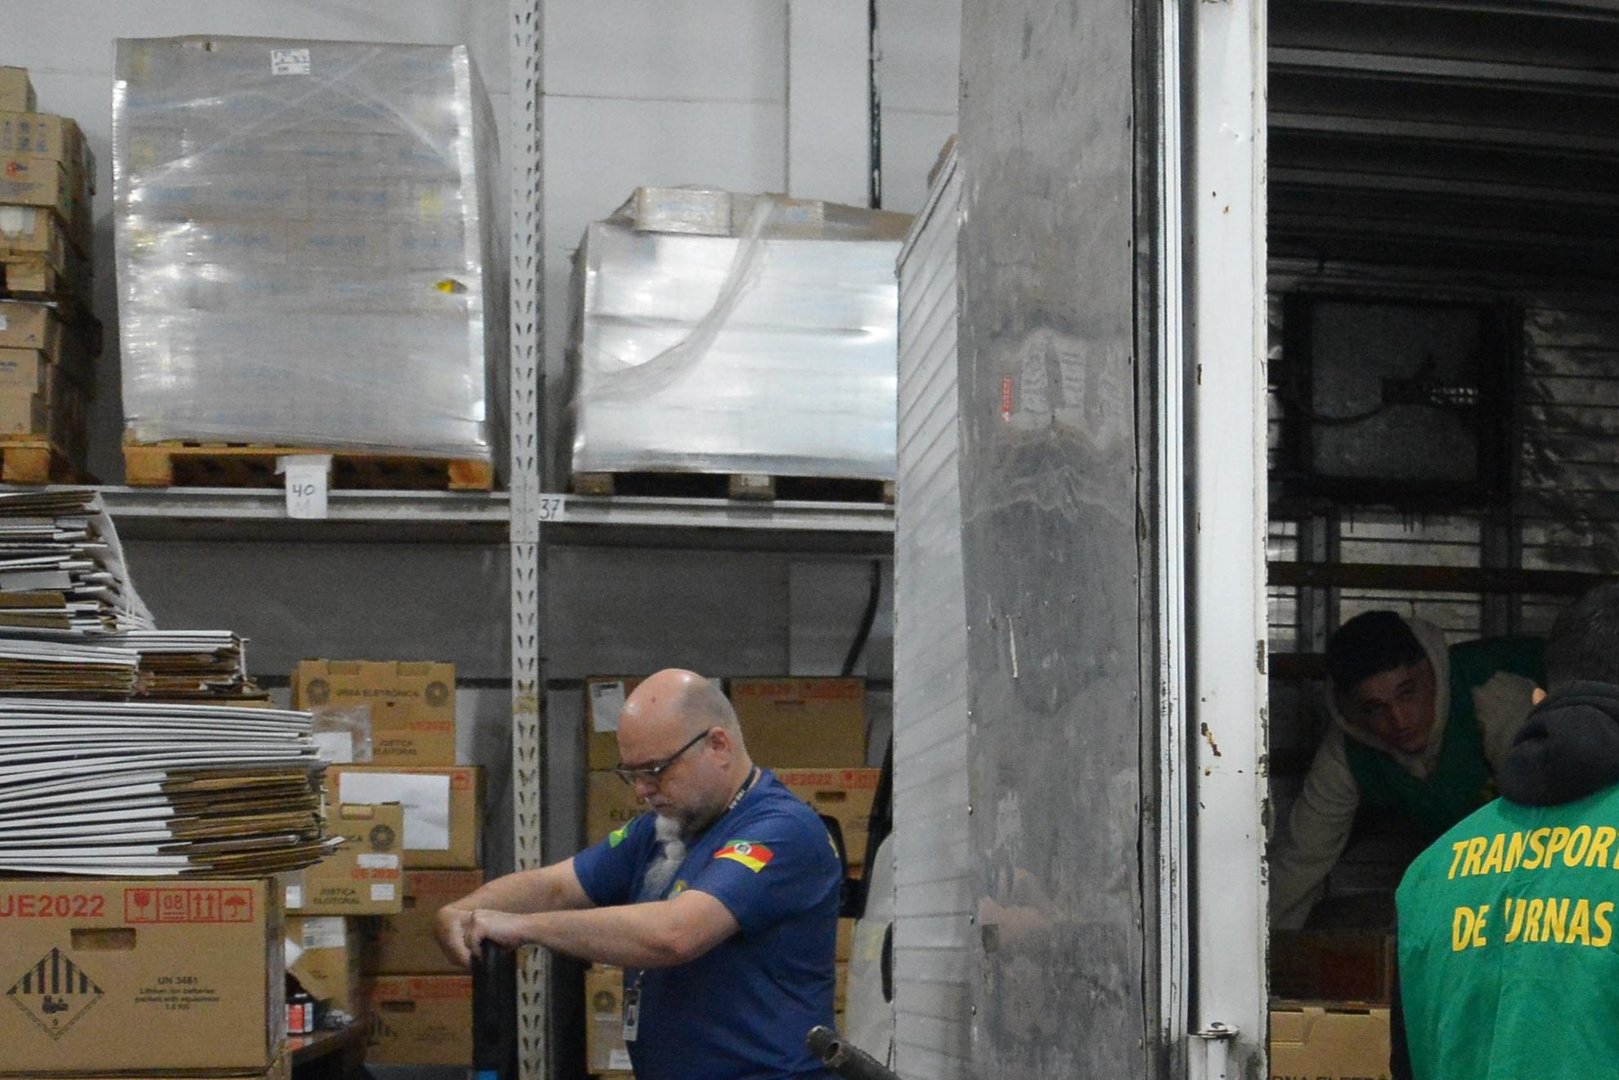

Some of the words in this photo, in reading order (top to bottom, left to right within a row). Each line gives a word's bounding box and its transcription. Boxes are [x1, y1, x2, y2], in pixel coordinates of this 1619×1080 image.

[292, 484, 316, 497] 40
[540, 499, 560, 519] 37
[1453, 905, 1490, 952] DE
[1505, 897, 1614, 947] URNAS
